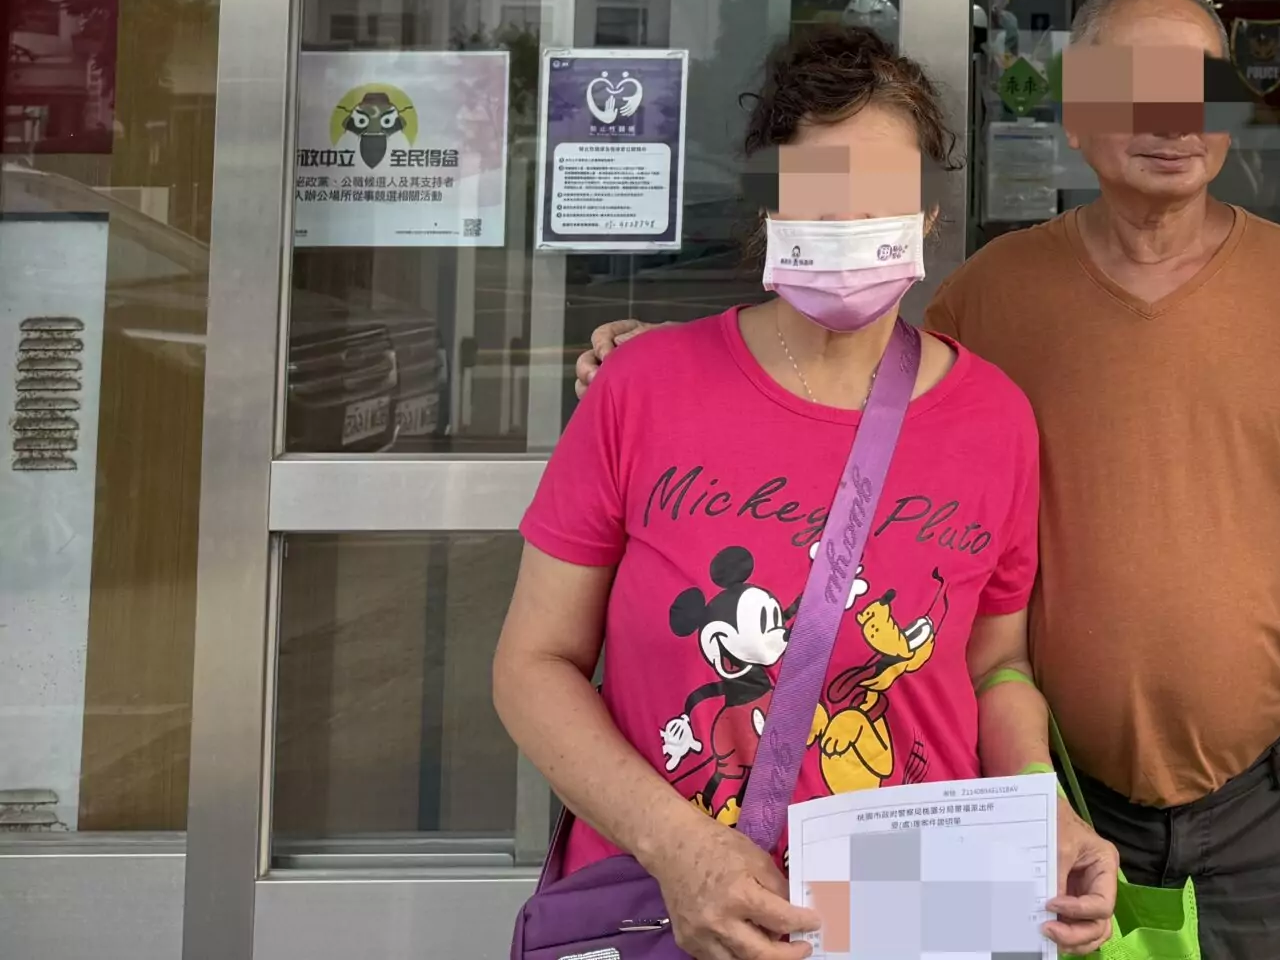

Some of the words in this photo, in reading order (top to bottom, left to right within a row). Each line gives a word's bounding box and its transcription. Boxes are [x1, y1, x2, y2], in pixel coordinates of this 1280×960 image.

[1246, 65, 1279, 80] POLICE
[390, 149, 459, 168] 全民得益
[644, 466, 829, 545] Mickey
[873, 495, 992, 556] Pluto
